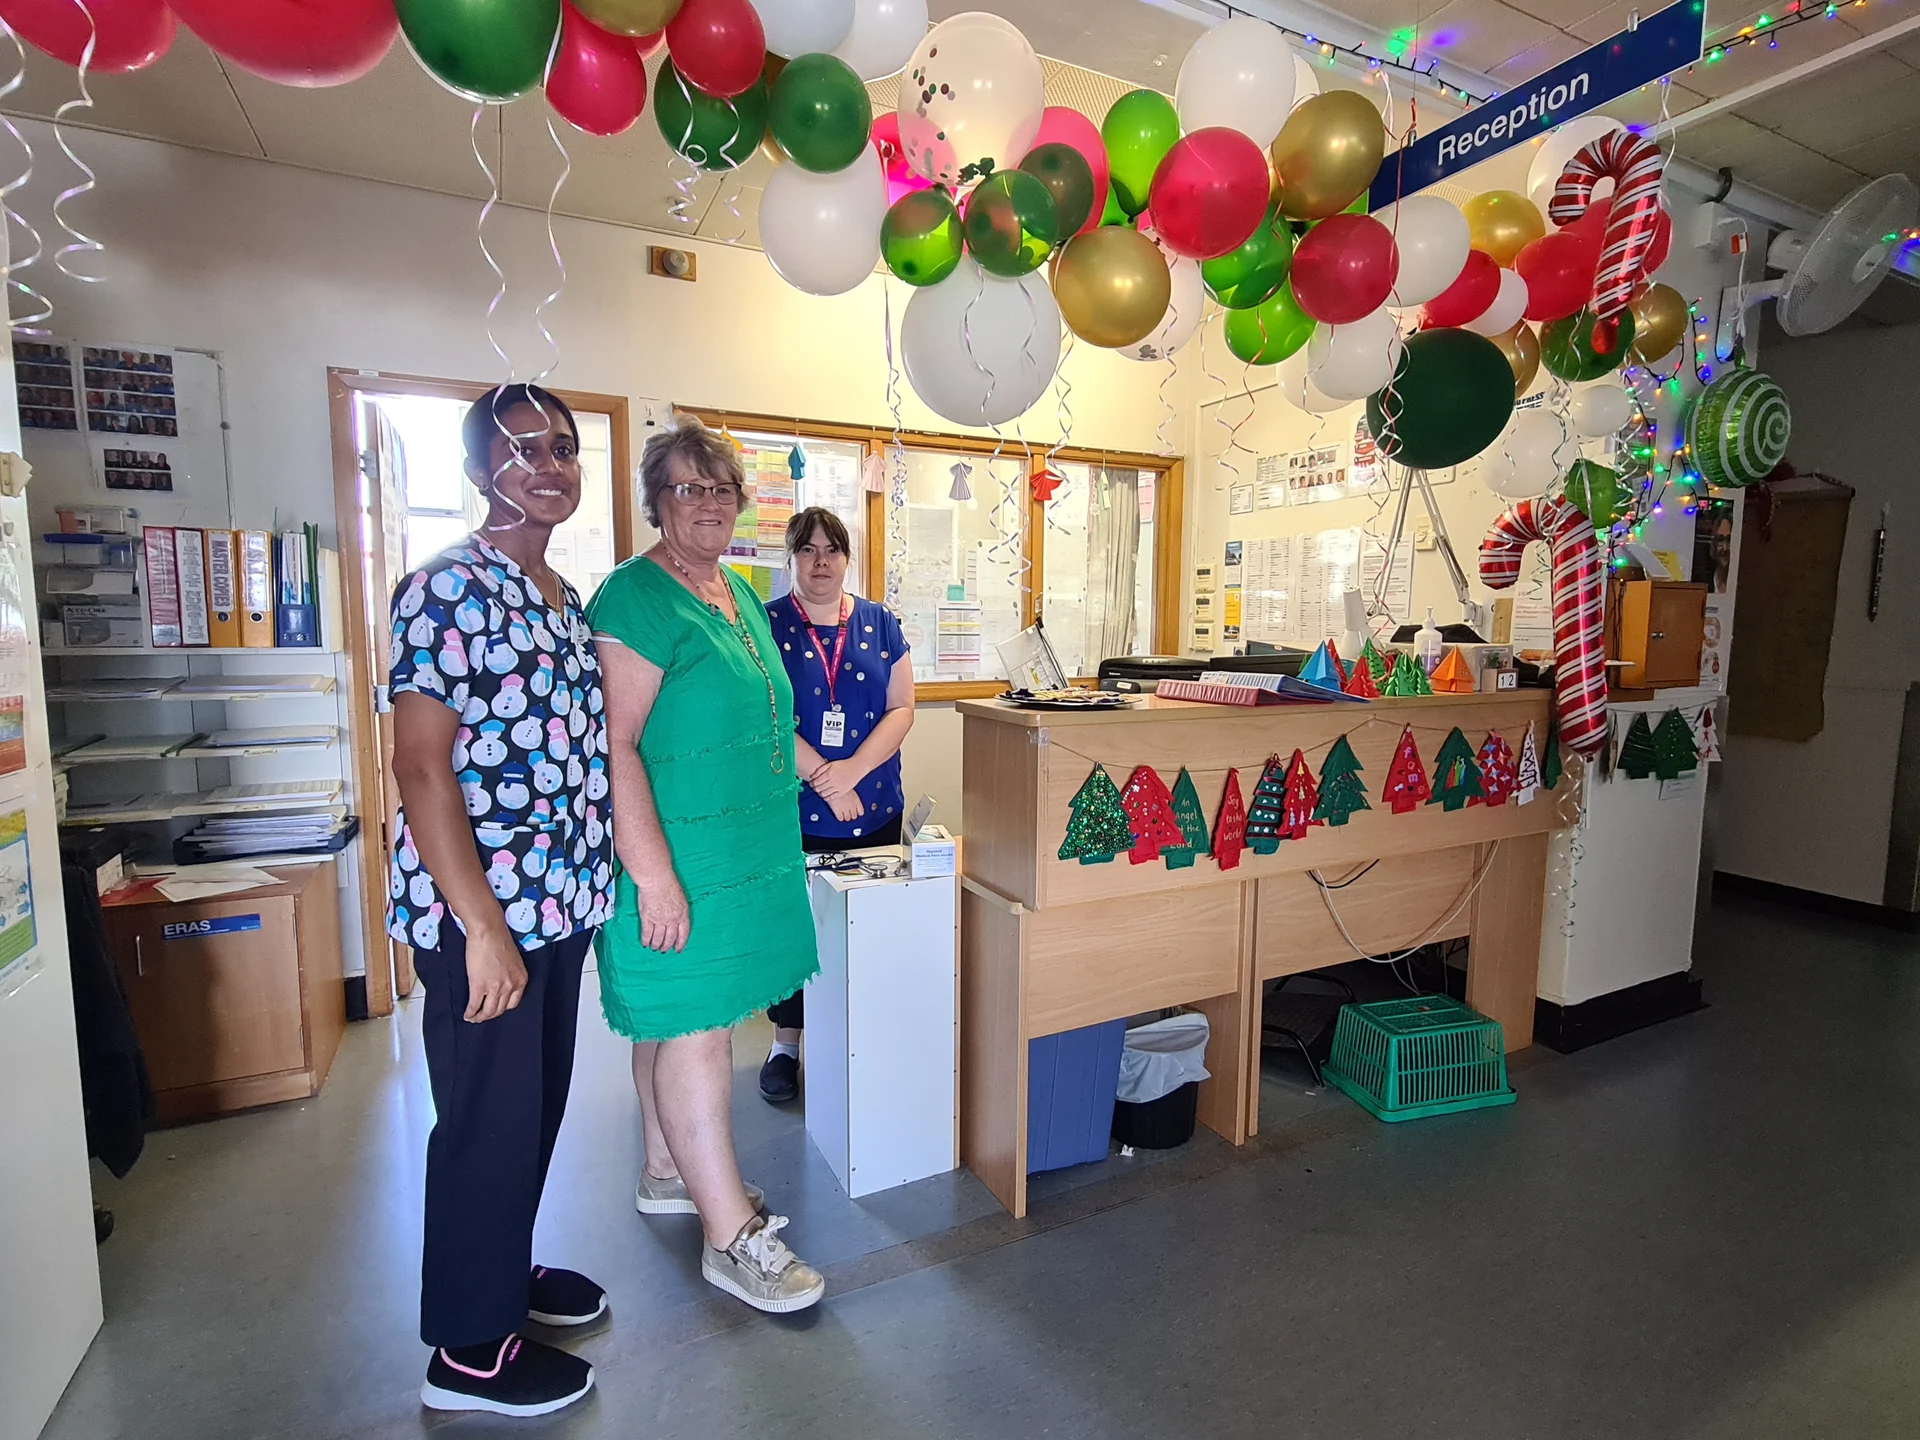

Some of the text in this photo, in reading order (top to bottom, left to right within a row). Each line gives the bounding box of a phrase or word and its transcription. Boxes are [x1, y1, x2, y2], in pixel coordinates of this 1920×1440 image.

[1436, 72, 1589, 166] Reception
[211, 540, 231, 608] MASTER COPIES
[825, 720, 843, 728] VIP
[1181, 798, 1190, 807] An
[1228, 793, 1239, 809] Joy
[1176, 808, 1198, 823] Angel
[164, 920, 211, 935] ERAS
